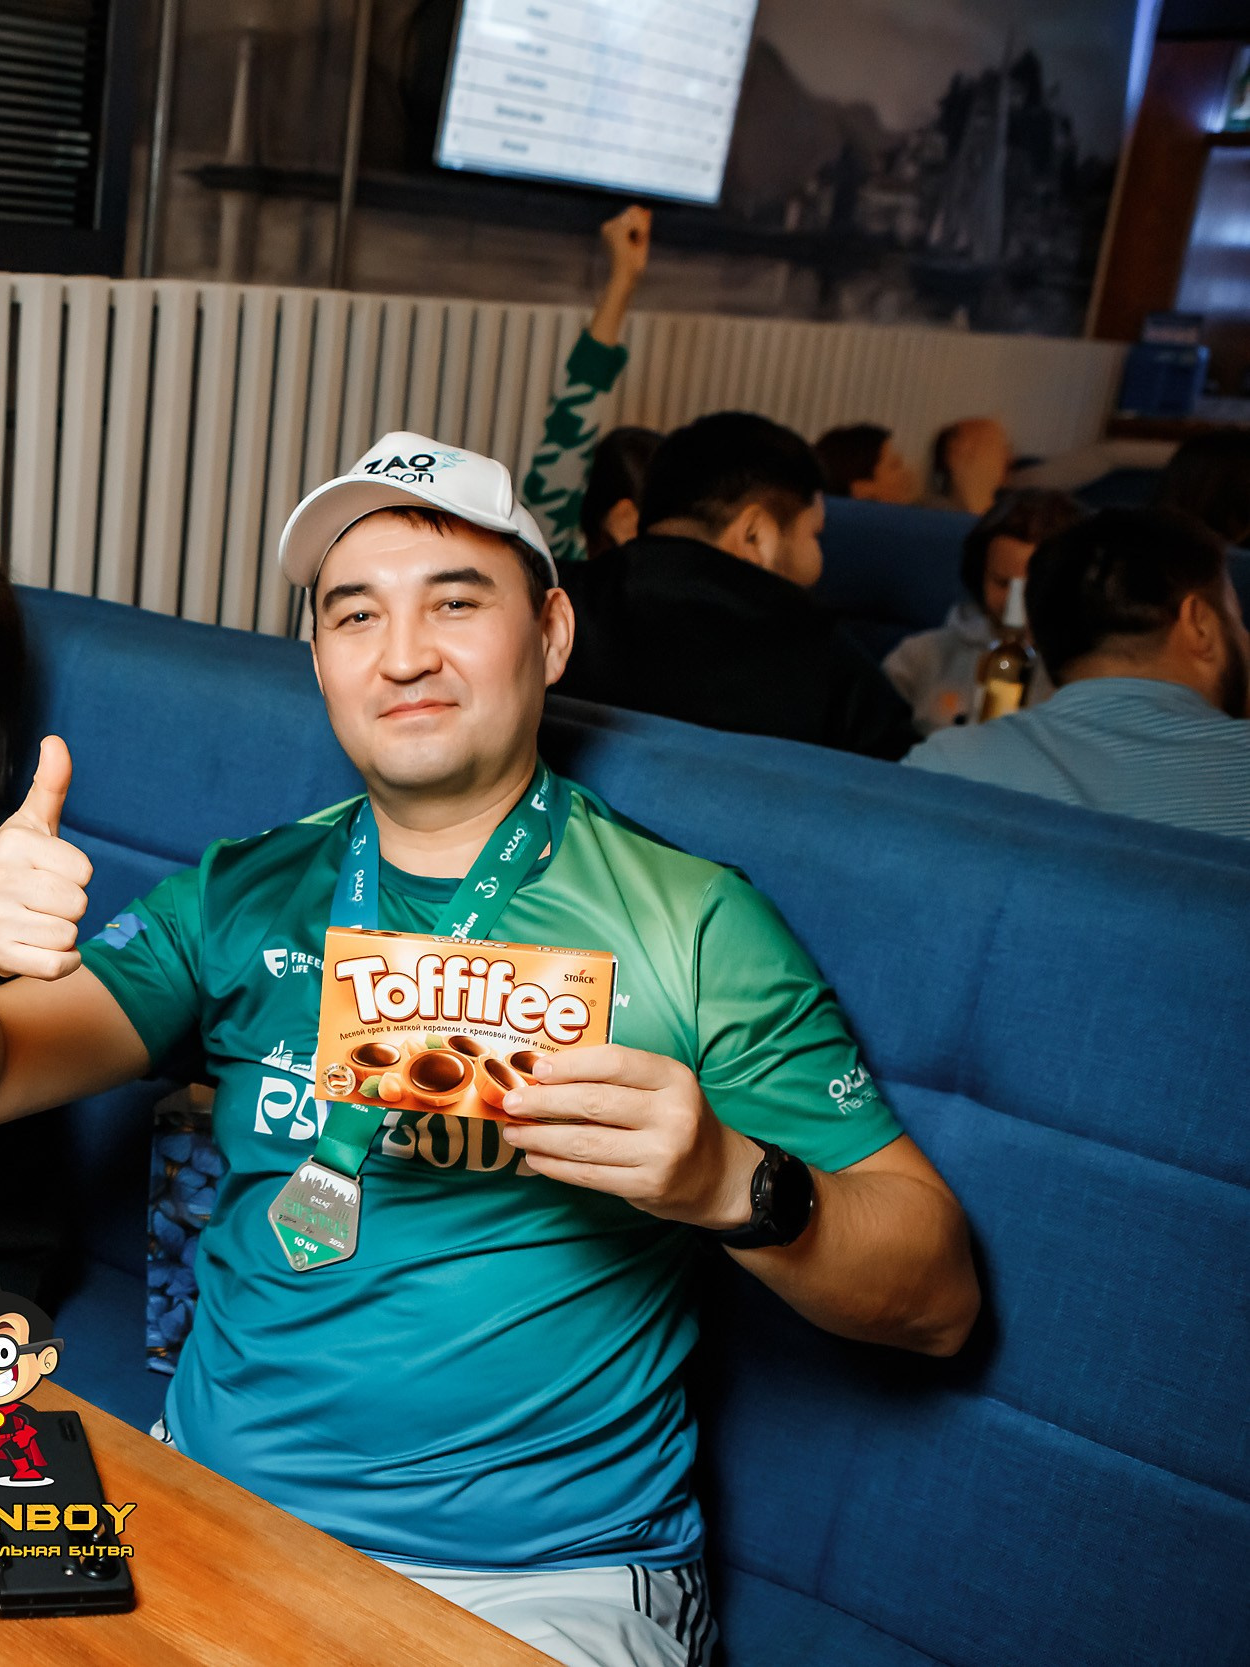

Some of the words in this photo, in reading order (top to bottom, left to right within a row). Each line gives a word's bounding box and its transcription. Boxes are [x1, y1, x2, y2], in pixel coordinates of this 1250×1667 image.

[499, 827, 528, 862] QAZAQ
[291, 951, 325, 971] FREE
[292, 965, 309, 974] LIFE
[563, 973, 595, 984] STORCK
[335, 954, 591, 1045] Toffifee
[339, 1028, 366, 1041] Лесной
[367, 1025, 385, 1036] орех
[393, 1024, 421, 1032] мягкой
[423, 1024, 461, 1034] карамели
[469, 1028, 507, 1040] кремовой
[508, 1034, 531, 1044] нугой
[293, 1236, 305, 1247] 10
[304, 1240, 319, 1254] KM
[329, 1237, 346, 1250] 2024
